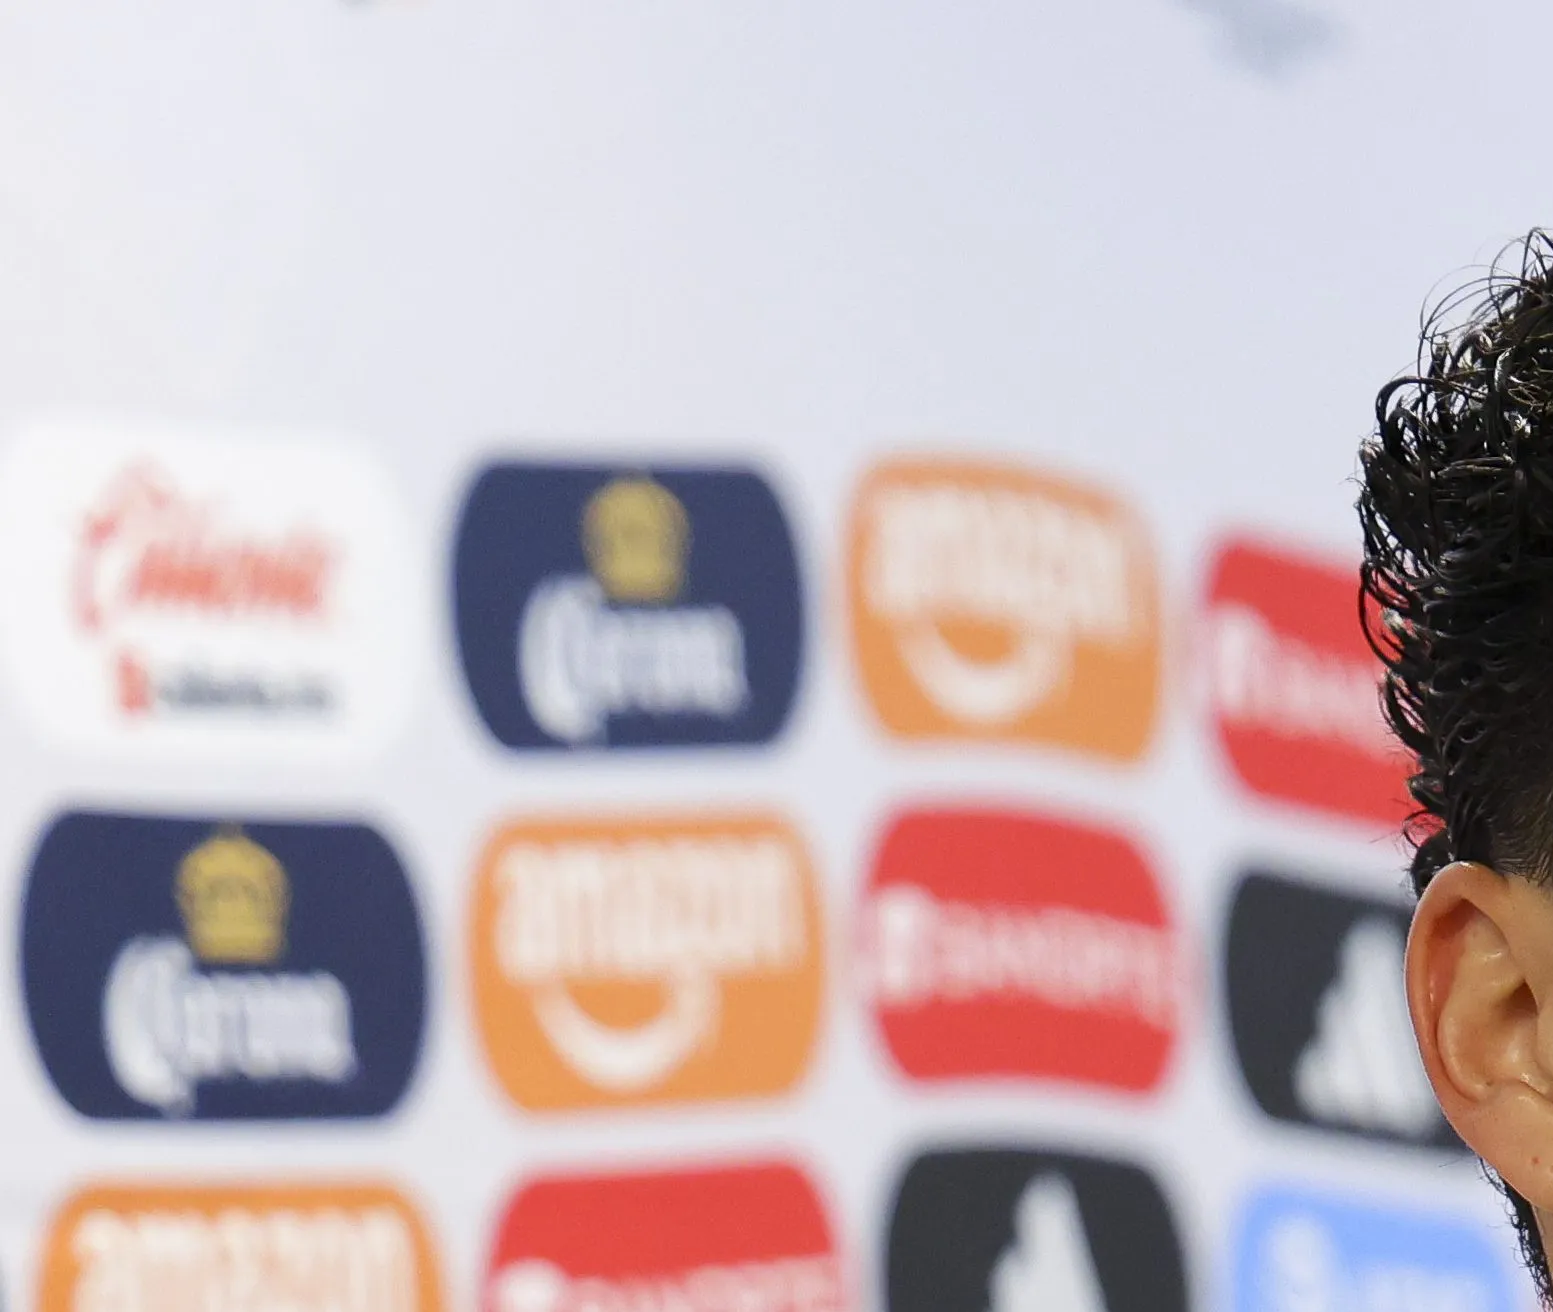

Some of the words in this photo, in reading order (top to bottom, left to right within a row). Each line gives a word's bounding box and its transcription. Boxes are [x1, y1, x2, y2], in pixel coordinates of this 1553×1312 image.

[868, 487, 1132, 642] amazon
[498, 845, 802, 985] amazon
[104, 937, 356, 1112] Corona
